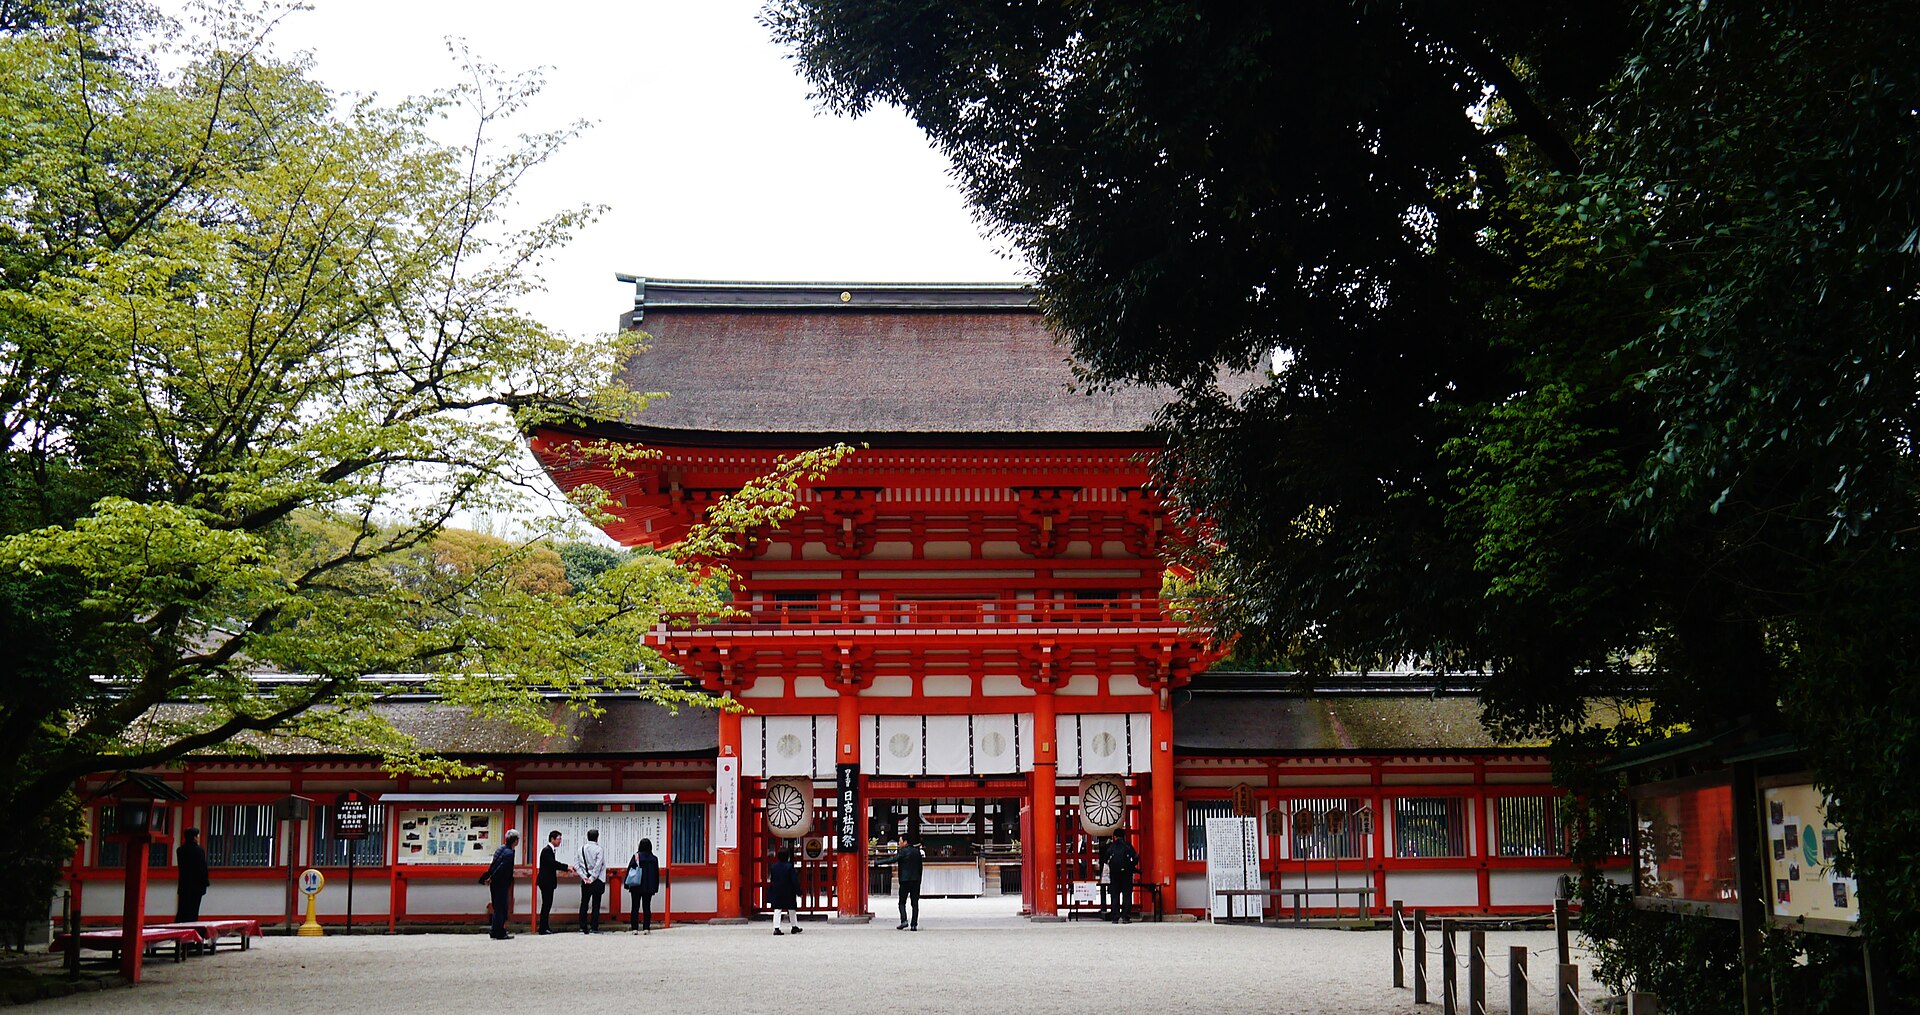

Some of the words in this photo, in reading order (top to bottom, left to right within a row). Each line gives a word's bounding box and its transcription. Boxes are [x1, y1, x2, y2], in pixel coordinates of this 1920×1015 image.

[842, 790, 855, 848] 日吉社例祭
